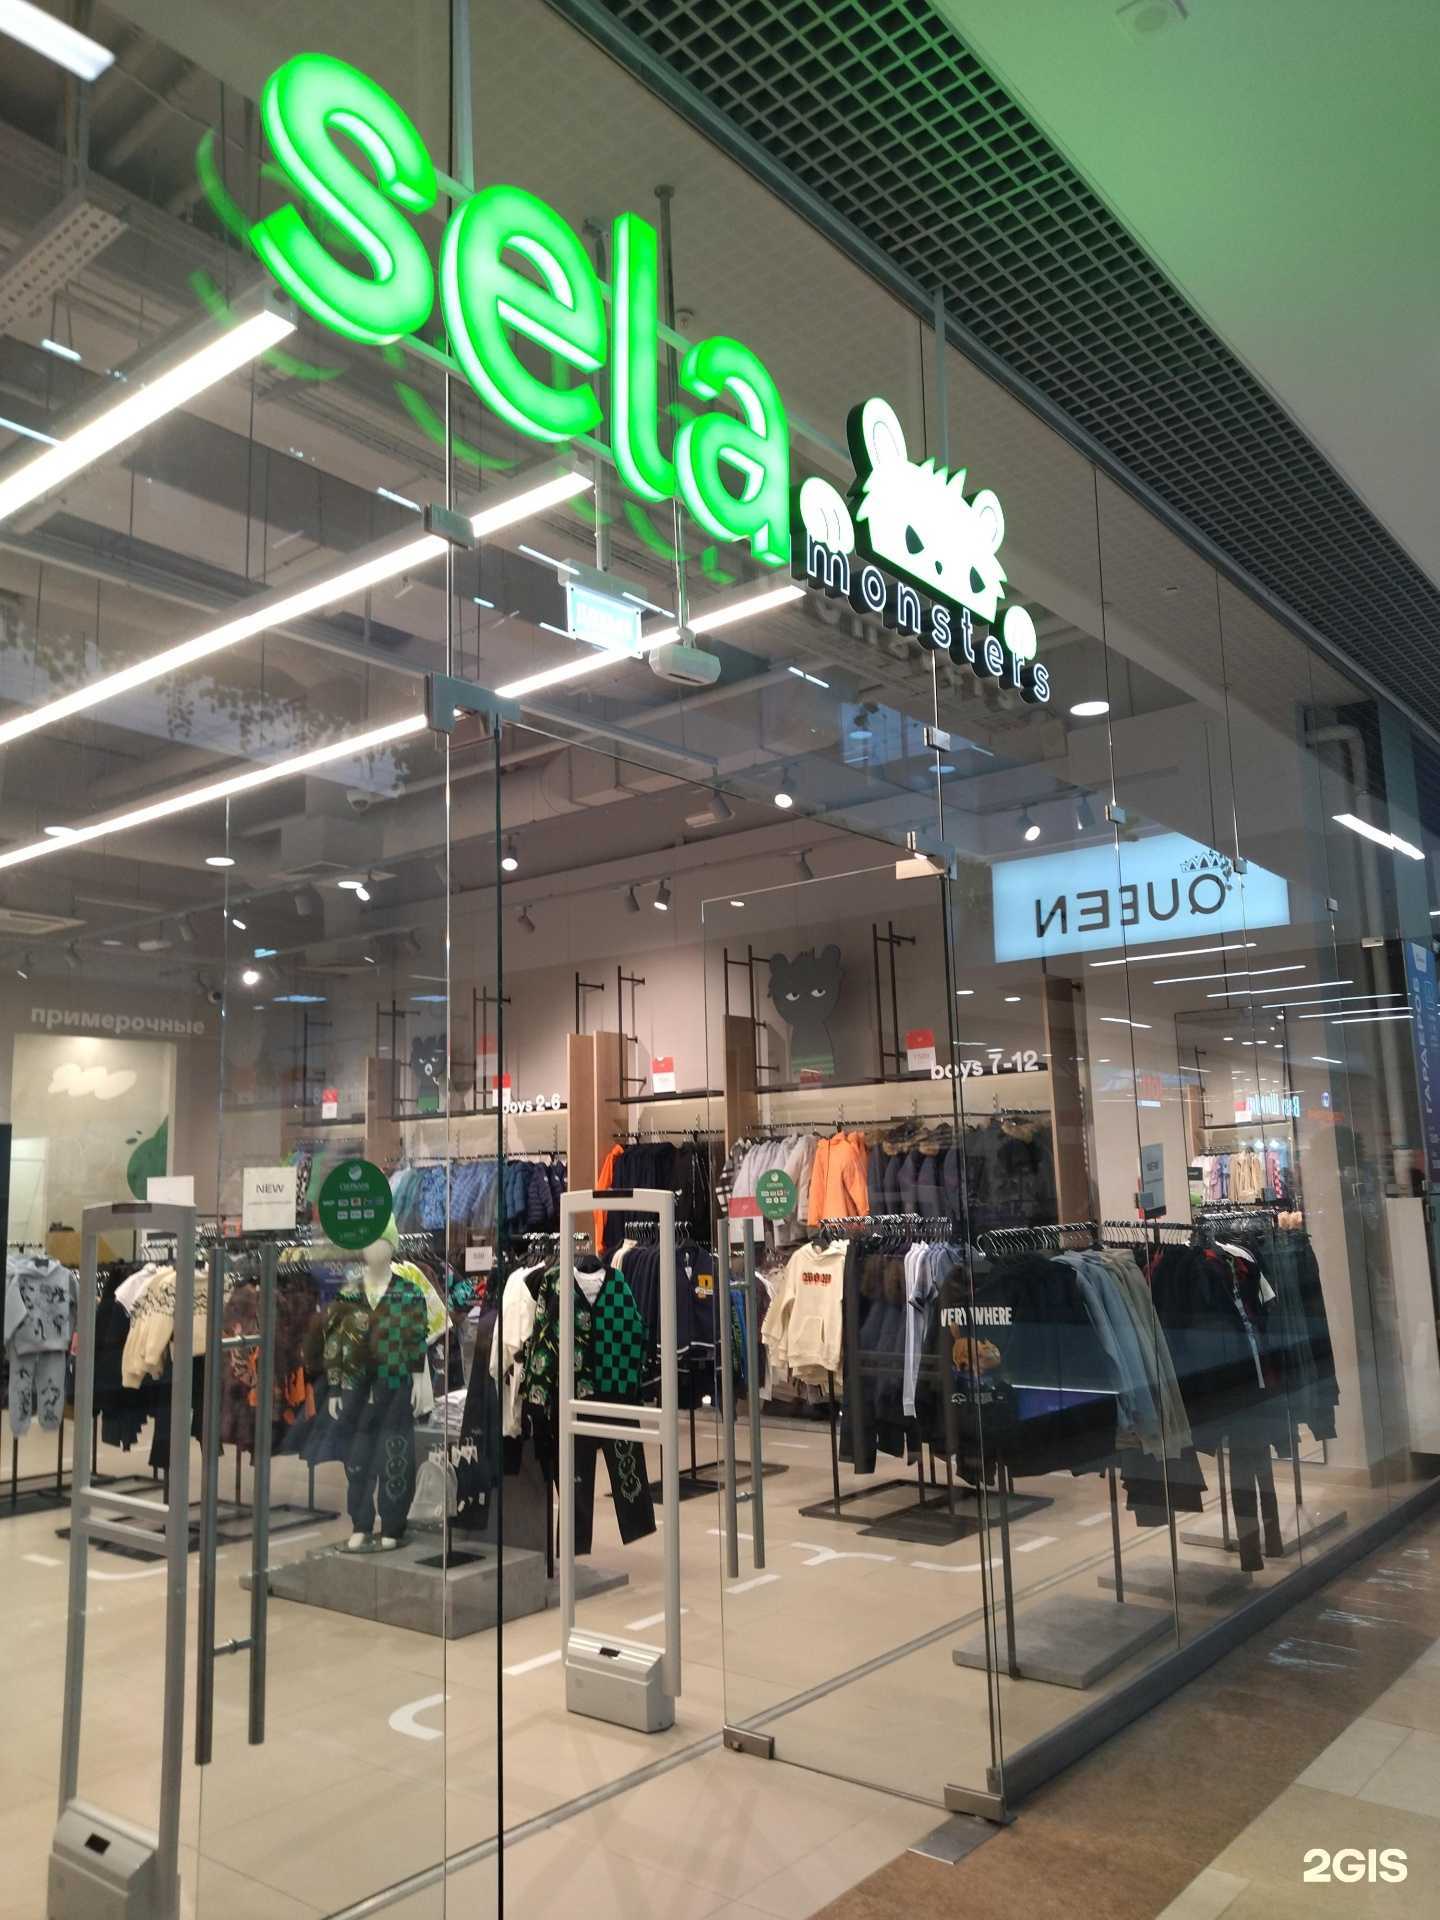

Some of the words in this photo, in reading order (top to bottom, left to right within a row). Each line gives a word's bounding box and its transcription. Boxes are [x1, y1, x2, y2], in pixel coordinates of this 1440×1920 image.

[807, 534, 1050, 703] monsters
[31, 1007, 205, 1035] примерочные
[931, 1059, 984, 1082] boys
[988, 1050, 1040, 1074] 7-12
[535, 1093, 561, 1112] 2-6
[256, 1183, 285, 1194] NEW
